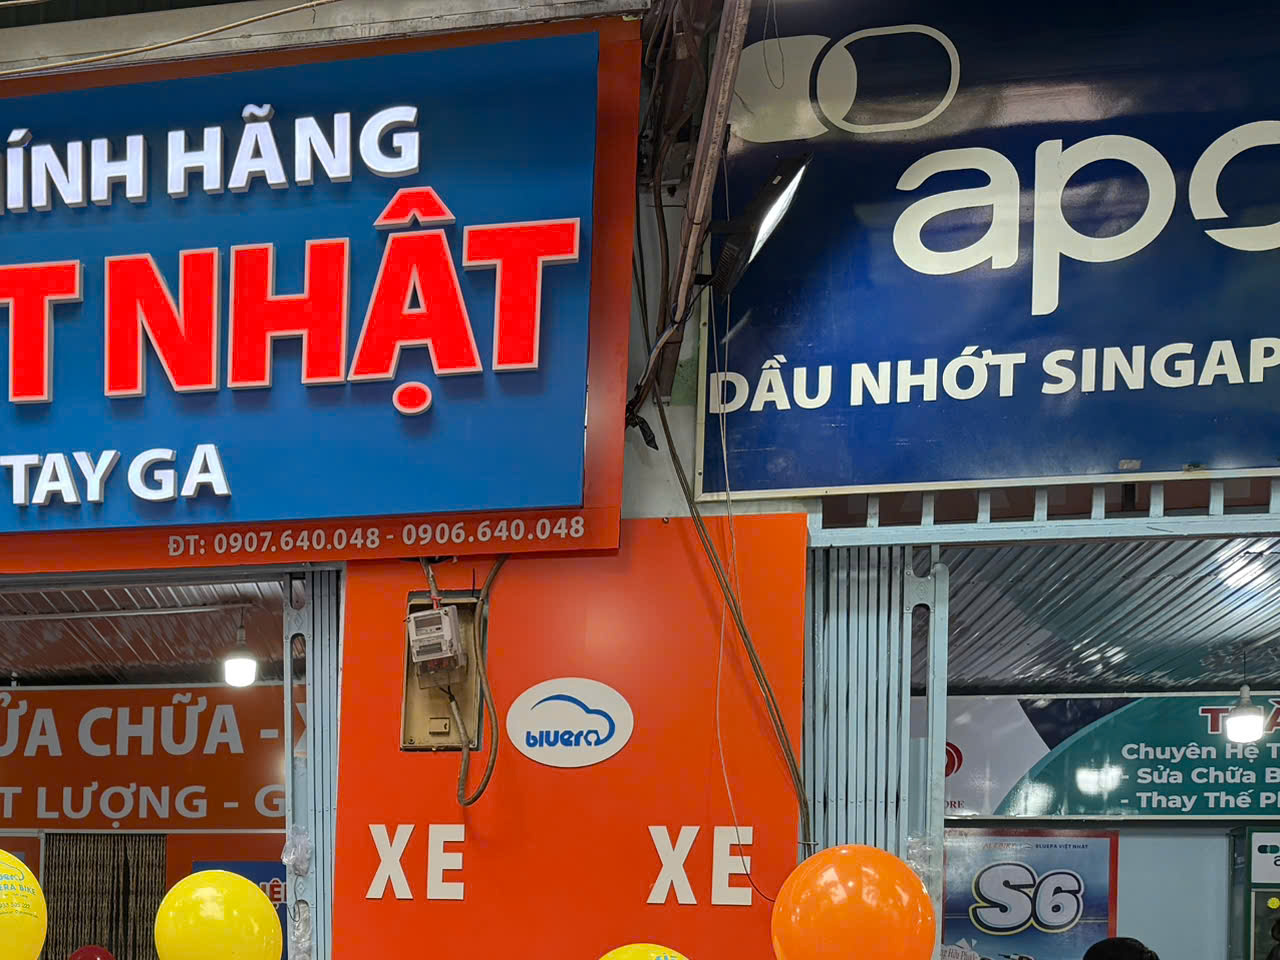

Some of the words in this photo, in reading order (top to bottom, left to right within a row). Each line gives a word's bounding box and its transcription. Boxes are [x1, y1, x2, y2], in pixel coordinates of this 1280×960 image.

[167, 103, 421, 197] HÃNG
[103, 185, 581, 416] NHẬT
[709, 354, 832, 414] DẦU
[850, 345, 1026, 407] NHỚT
[0, 450, 121, 507] TAY
[127, 443, 232, 501] GA
[168, 535, 206, 556] ĐT:
[214, 528, 381, 554] 0907.640.048
[402, 516, 585, 546] 0906.640.048
[77, 692, 245, 755] CHỮA
[1121, 742, 1217, 763] Chuyên
[1225, 743, 1260, 763] Hệ
[36, 781, 208, 830] LƯỢNG
[1136, 765, 1183, 784] Sửa
[1191, 766, 1256, 784] Chữa
[1136, 792, 1198, 812] Thay
[1204, 789, 1252, 808] Thế
[366, 824, 466, 901] XE
[647, 825, 754, 906] XE
[969, 862, 1084, 936] S6
